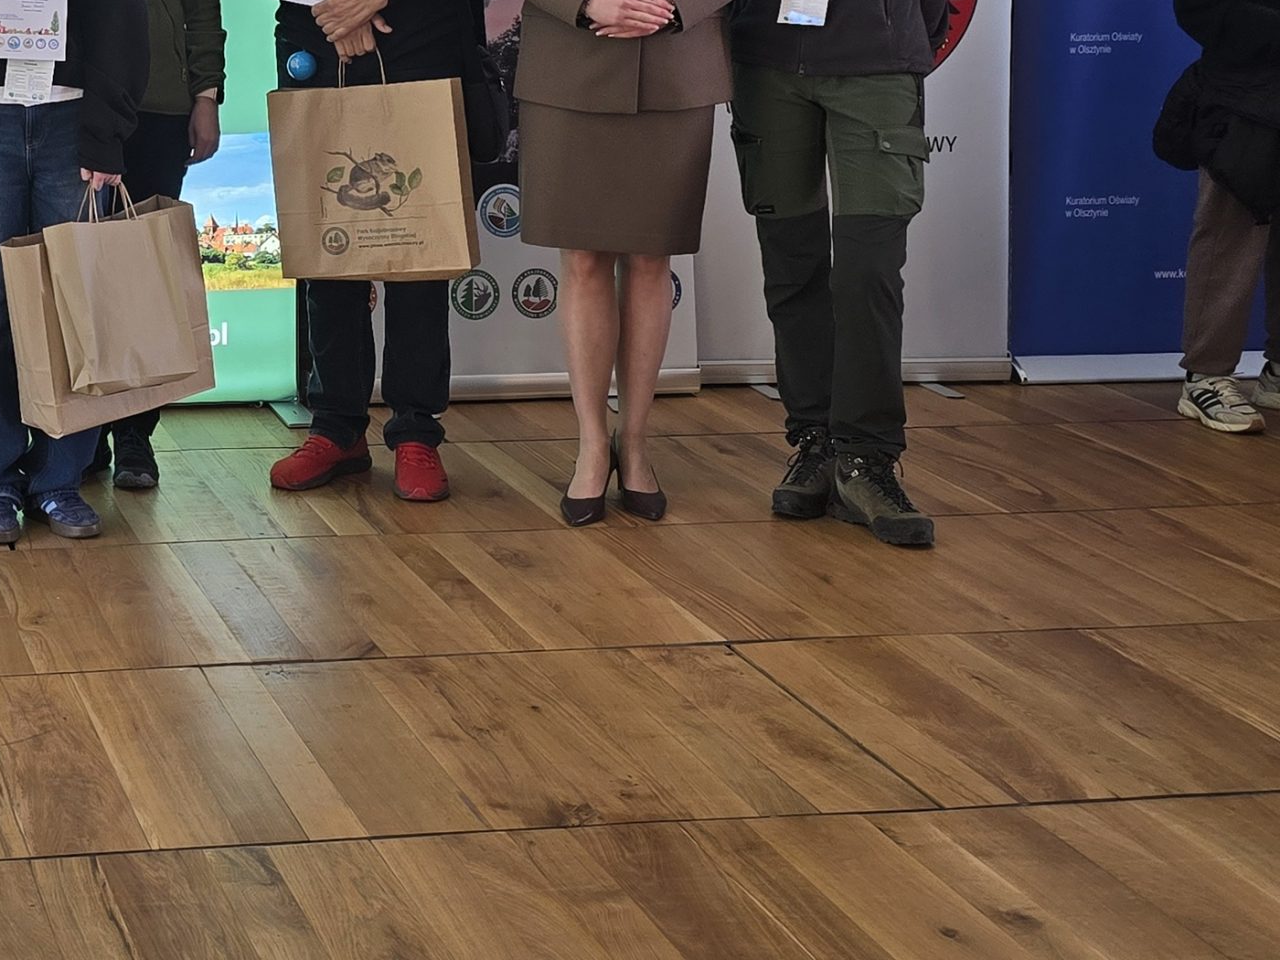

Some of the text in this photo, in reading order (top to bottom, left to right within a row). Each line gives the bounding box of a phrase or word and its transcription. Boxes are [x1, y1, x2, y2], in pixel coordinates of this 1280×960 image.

[1070, 33, 1110, 42] Kuratorium
[1077, 44, 1112, 56] Olsztynie
[209, 322, 228, 346] pl
